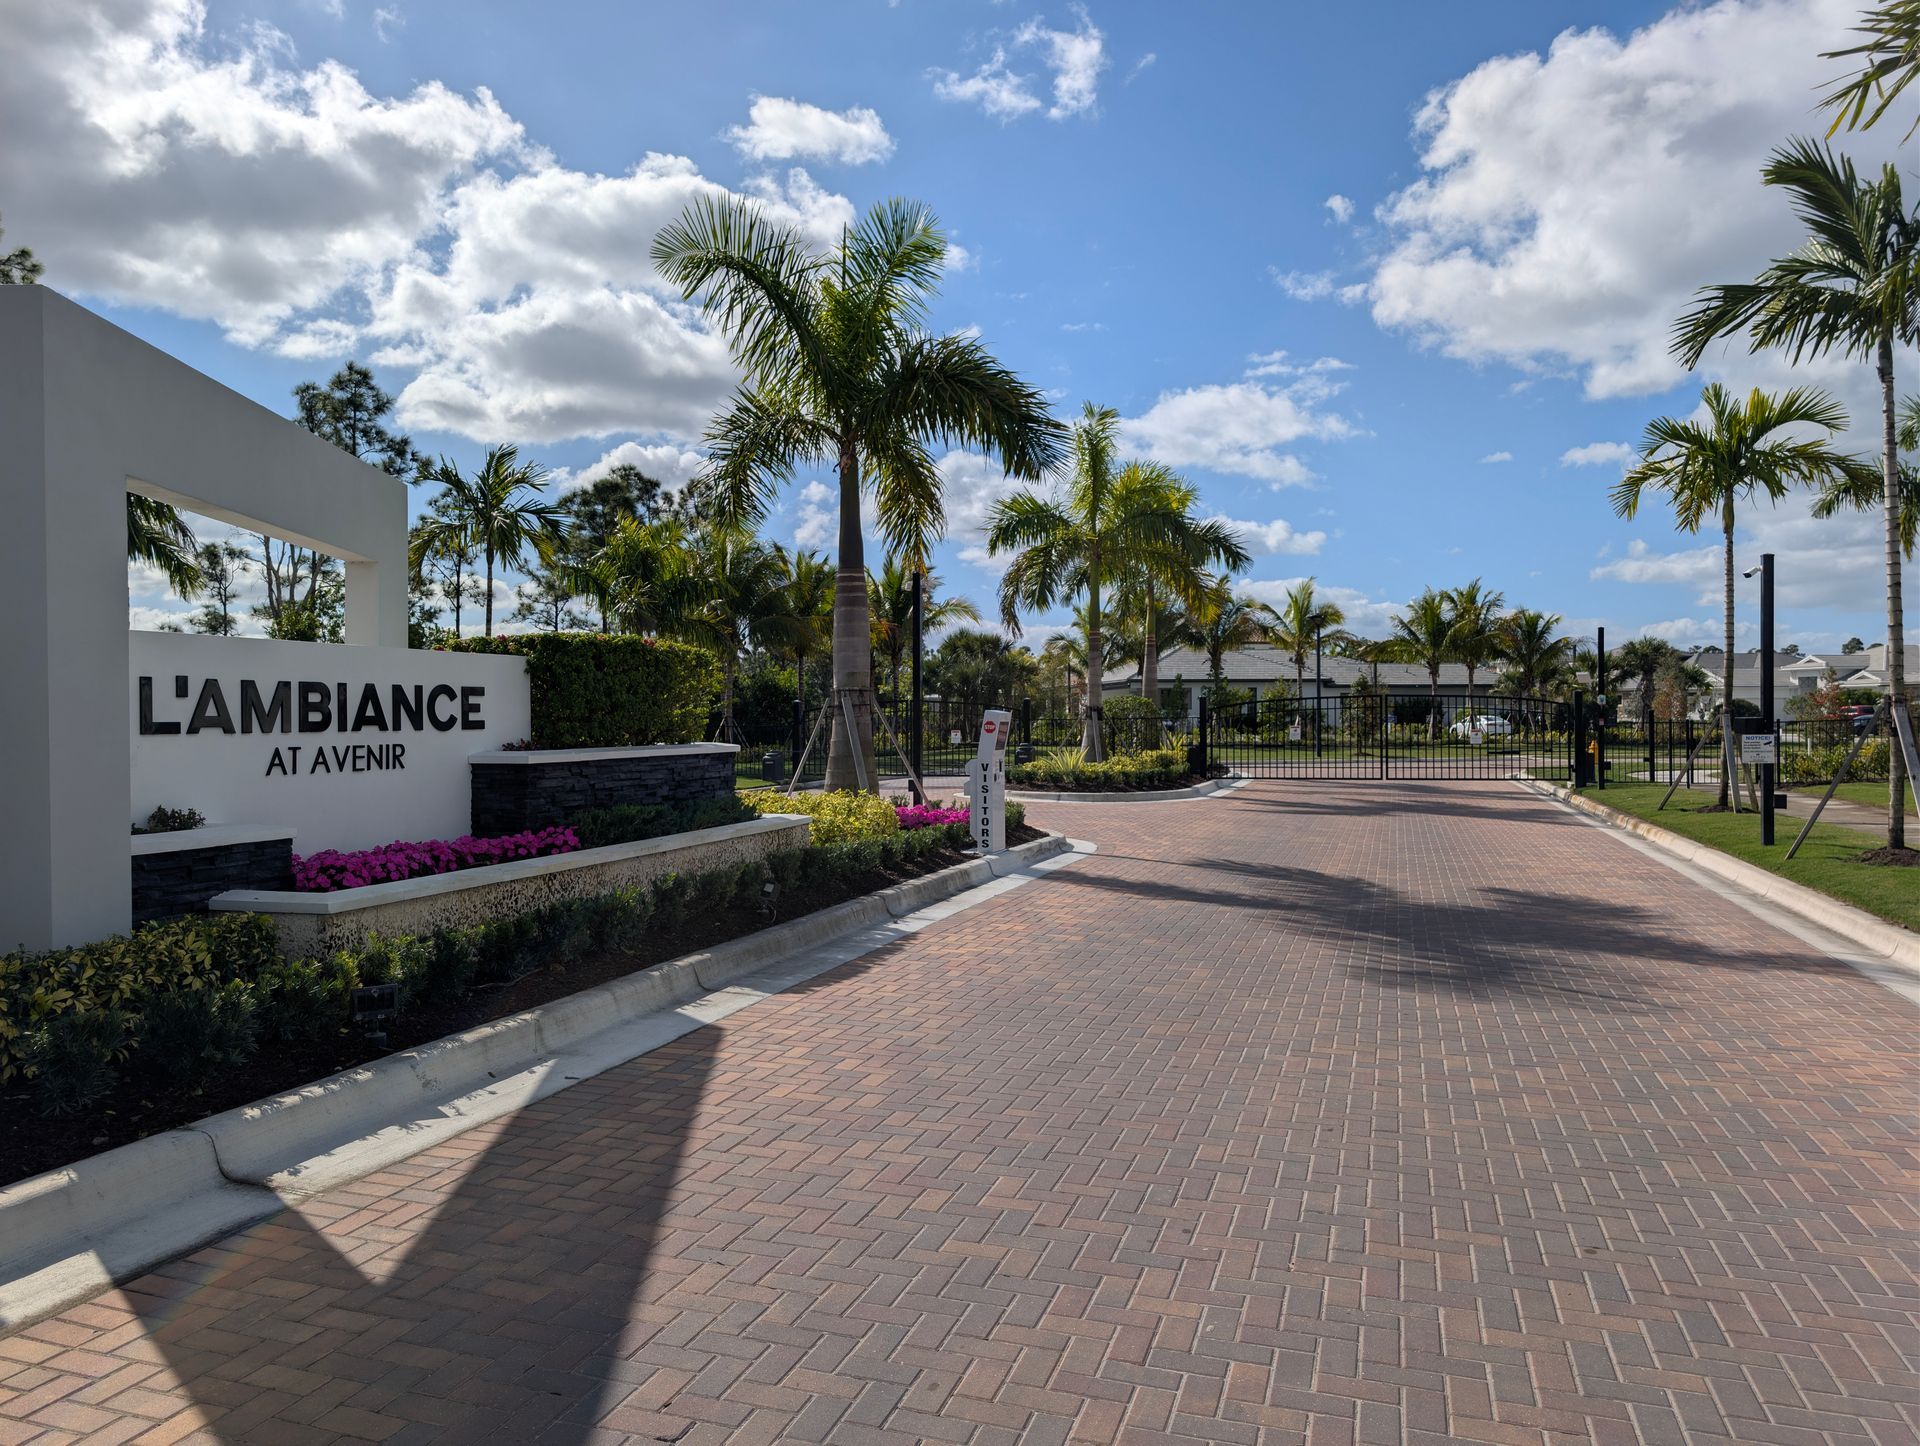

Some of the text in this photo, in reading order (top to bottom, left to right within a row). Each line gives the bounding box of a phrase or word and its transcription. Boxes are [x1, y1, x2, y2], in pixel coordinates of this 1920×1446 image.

[139, 675, 485, 735] L'AMBIANCE
[265, 743, 406, 776] AT AVENIR
[981, 763, 989, 848] VISITORS
